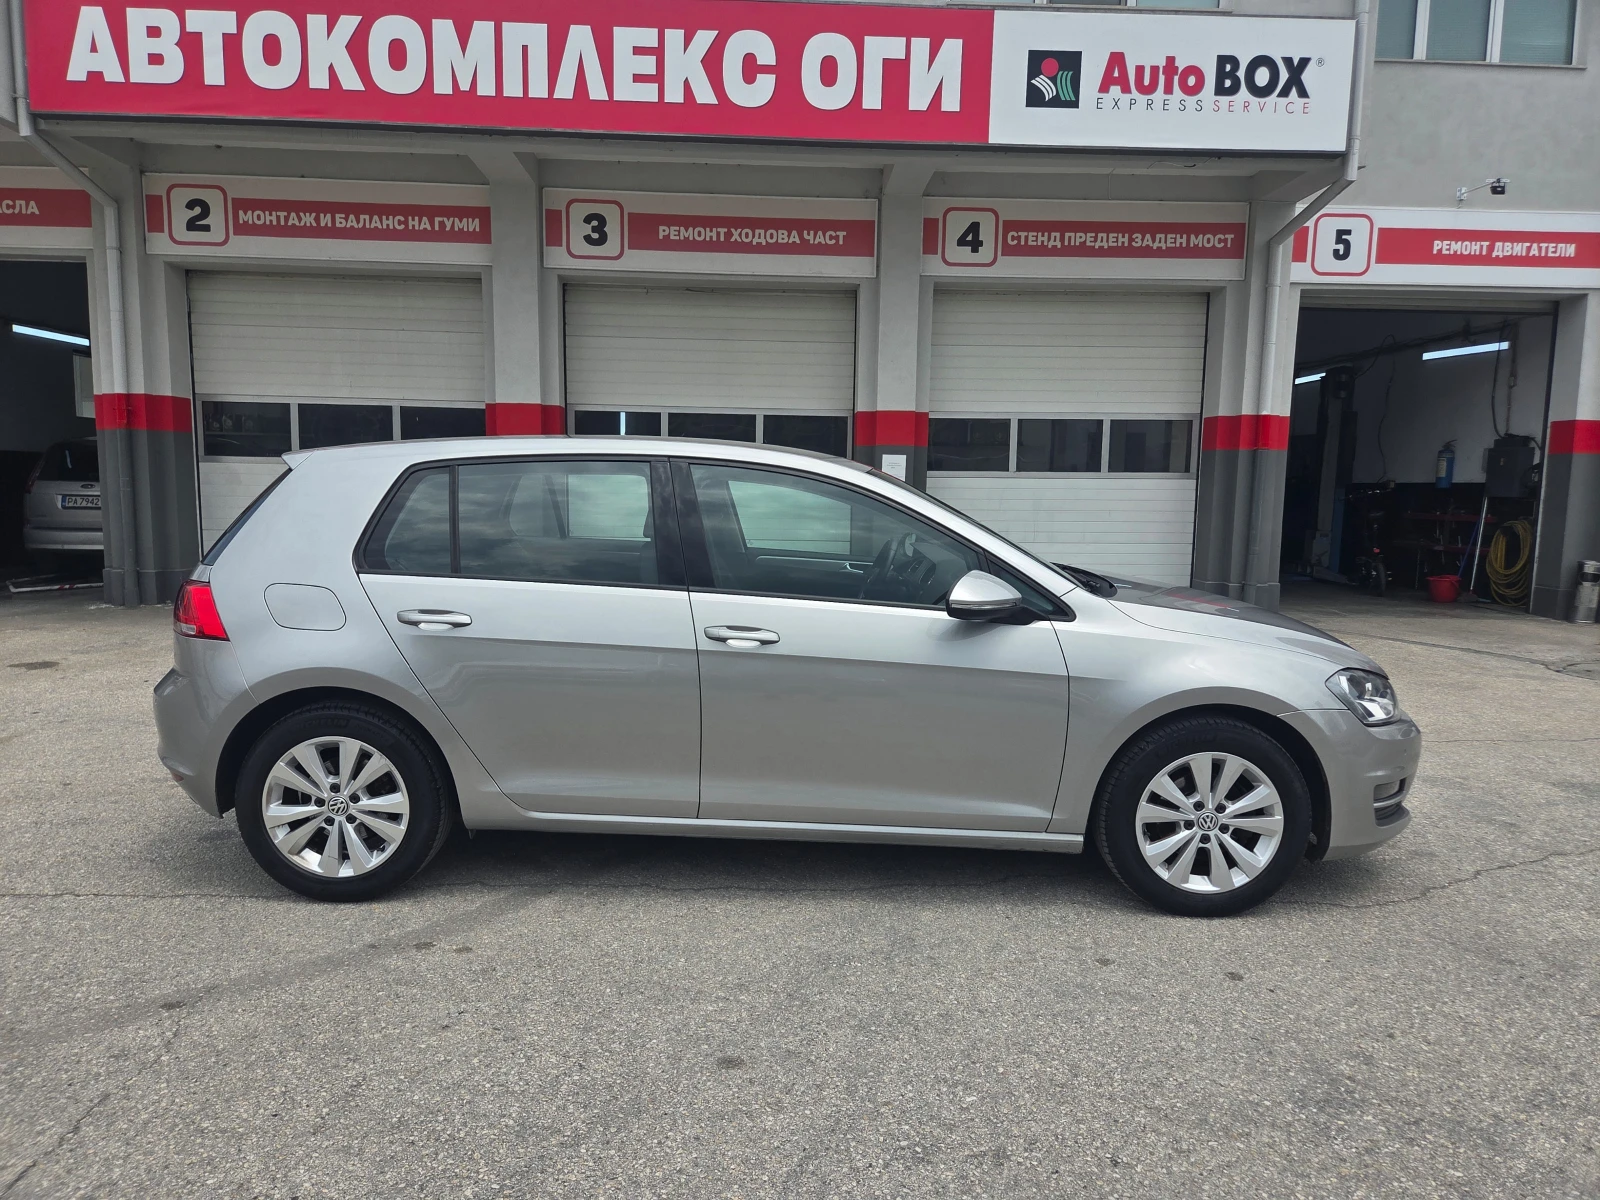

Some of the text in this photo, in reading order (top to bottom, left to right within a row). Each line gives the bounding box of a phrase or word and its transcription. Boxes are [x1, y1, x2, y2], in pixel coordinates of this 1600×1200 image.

[66, 5, 964, 113] АВТОКОМПЛЕКС ОГИ
[1097, 51, 1206, 97] Auto
[1213, 54, 1312, 99] BOX
[1096, 97, 1310, 114] EXPRESS SERVICE
[184, 197, 212, 233] 2
[238, 209, 480, 232] МОНТАЖ И БАЛАНС НА ГУМИ
[582, 212, 608, 247] 3
[658, 225, 847, 245] РЕМОНТ ХОДОВА ЧАСТ
[956, 221, 984, 254] 4
[1007, 231, 1235, 249] СТЕНД ПРЕДЕН ЗАДЕН МОСТ
[1332, 229, 1352, 261] 5
[1433, 240, 1576, 258] РЕМОНТ ДВИГАТЕЛИ
[67, 497, 100, 505] PA 7942
